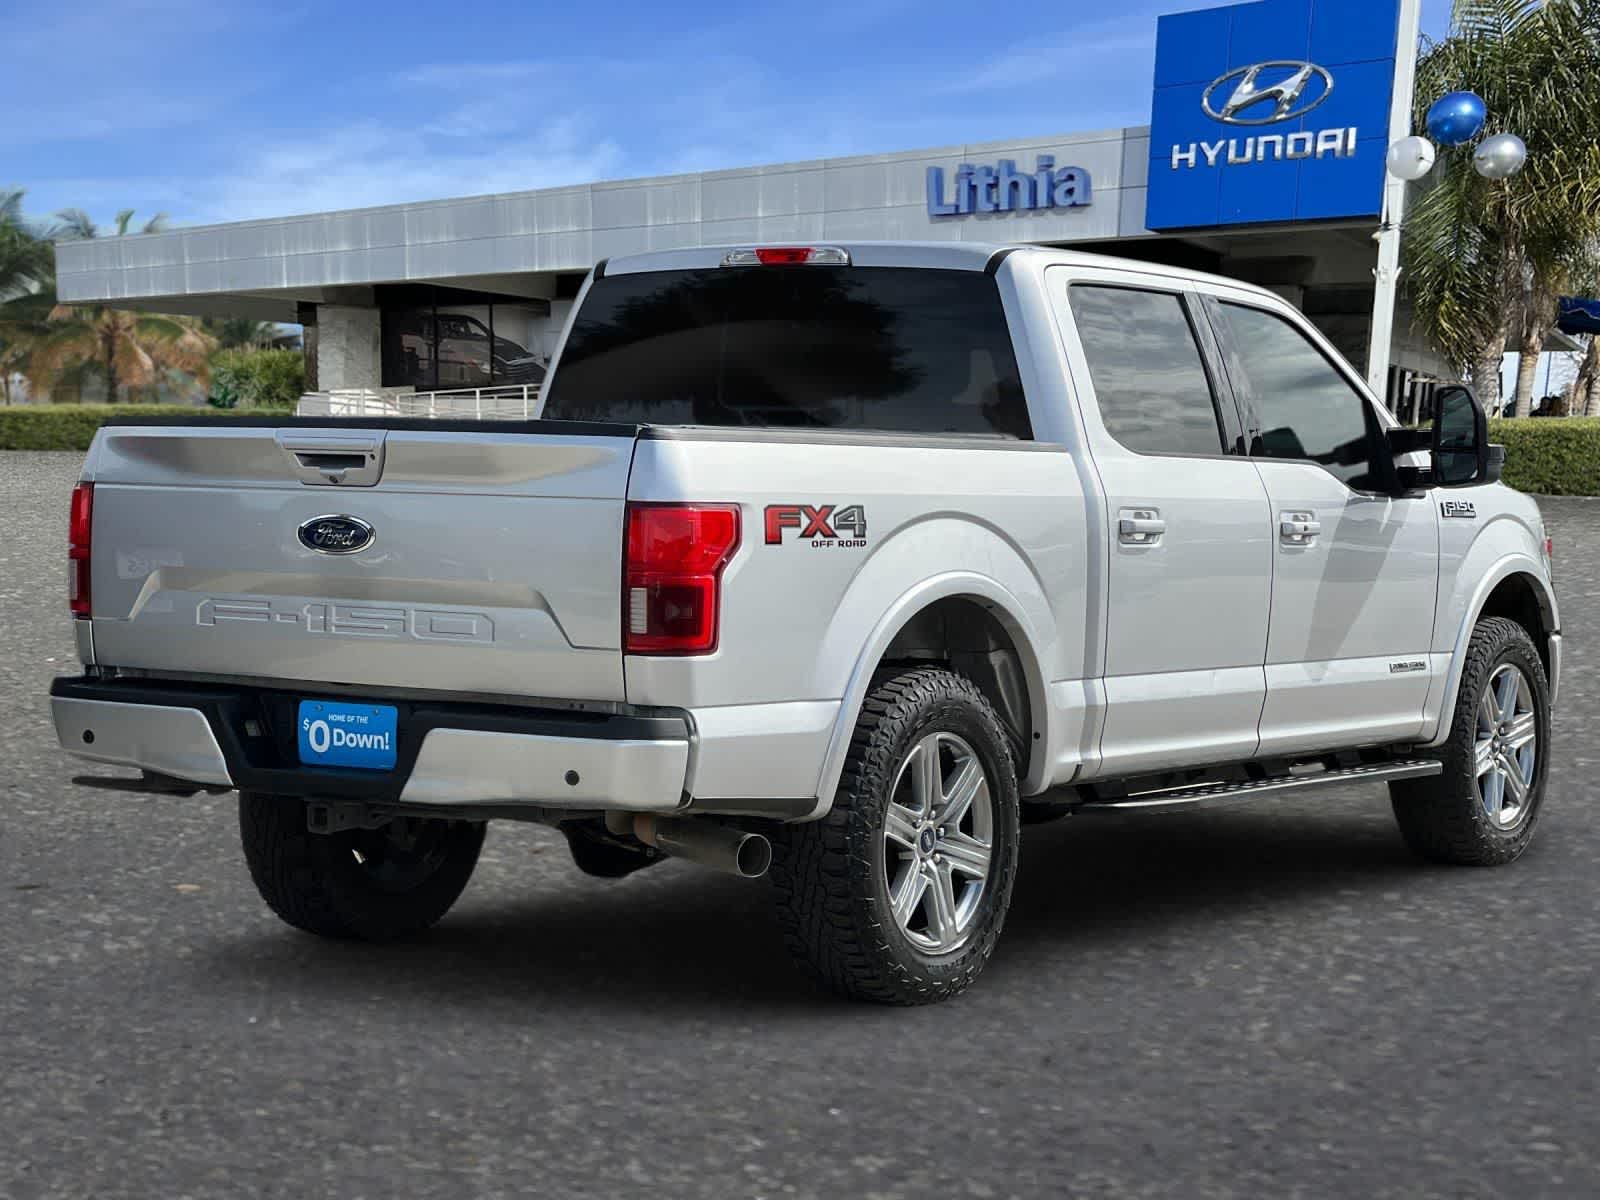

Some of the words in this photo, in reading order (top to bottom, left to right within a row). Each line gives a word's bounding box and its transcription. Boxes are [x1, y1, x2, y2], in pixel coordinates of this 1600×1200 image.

[1170, 127, 1357, 169] HYUNDAI
[926, 155, 1093, 217] Lithia
[313, 523, 355, 546] Ford
[764, 504, 867, 545] FX4
[811, 540, 834, 548] OFF
[838, 540, 867, 548] ROAD
[196, 598, 496, 643] F-150
[328, 713, 346, 722] HOME
[346, 714, 355, 723] OF
[355, 715, 369, 724] THE
[333, 728, 390, 750] Down!
